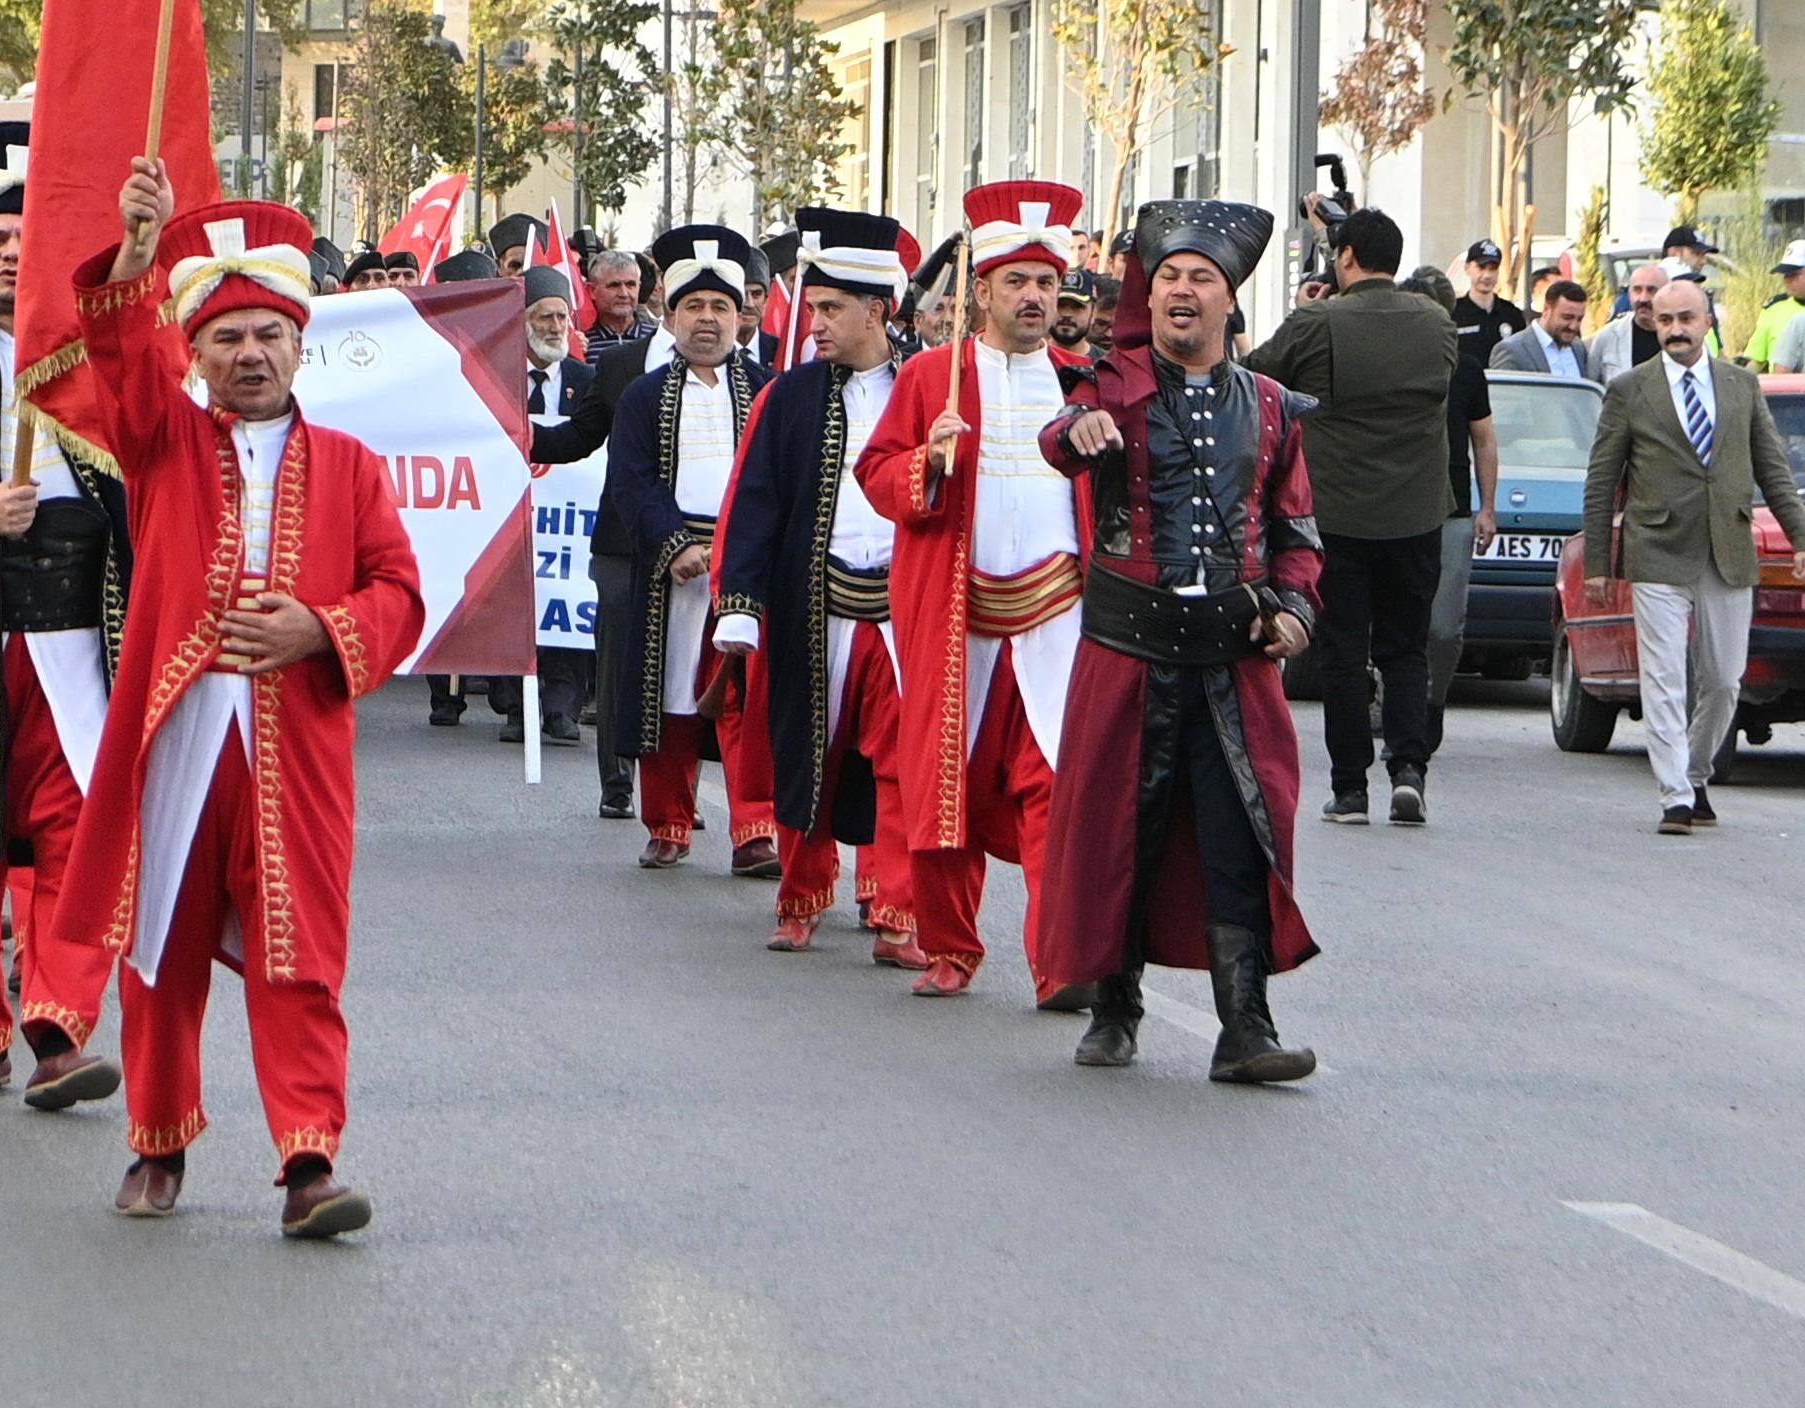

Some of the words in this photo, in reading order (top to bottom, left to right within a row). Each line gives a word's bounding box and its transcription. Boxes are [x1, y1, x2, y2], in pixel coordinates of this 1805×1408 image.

[531, 501, 598, 537] HİT
[535, 545, 572, 580] Zİ
[1496, 535, 1532, 559] AES
